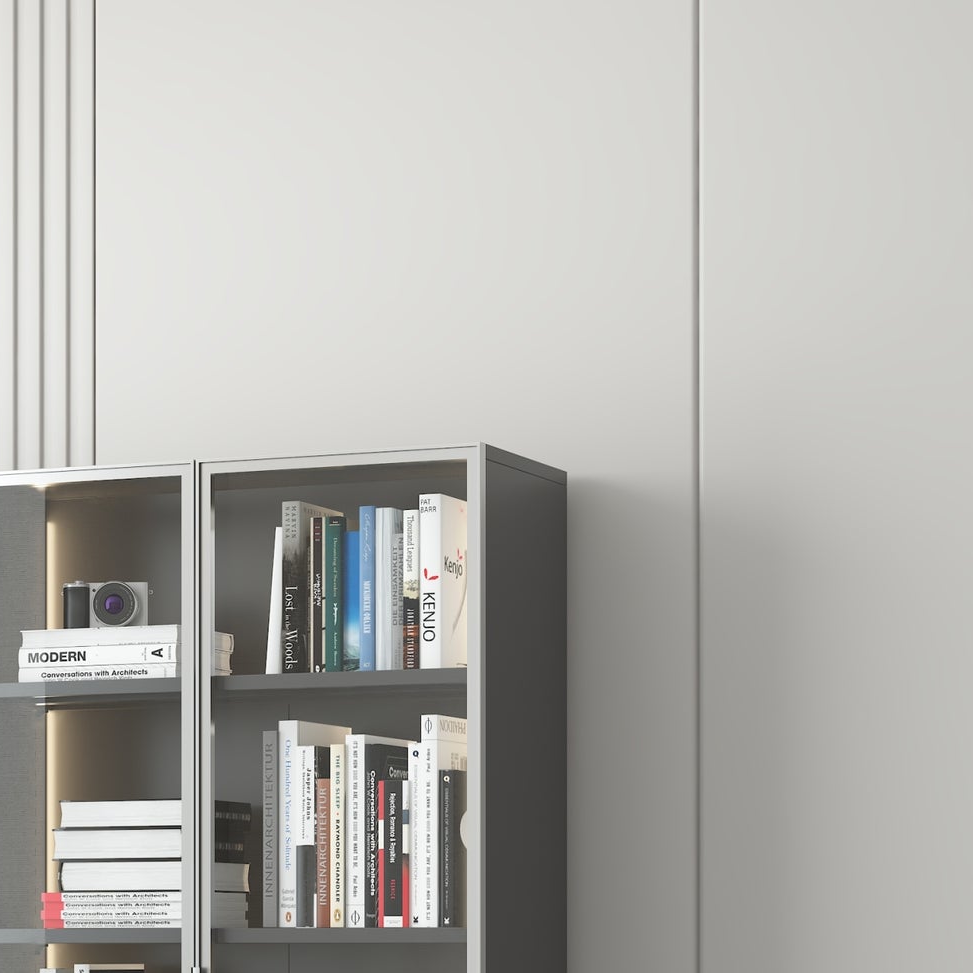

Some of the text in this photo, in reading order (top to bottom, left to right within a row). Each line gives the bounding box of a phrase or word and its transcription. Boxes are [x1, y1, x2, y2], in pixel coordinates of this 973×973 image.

[405, 515, 414, 573] Thousand Leagues
[445, 556, 463, 579] Kenjo
[285, 586, 298, 611] Lost
[423, 592, 435, 642] KENJO
[28, 651, 86, 663] MODERN
[285, 629, 298, 670] Woods
[41, 668, 148, 679] Conversations with Architects
[319, 788, 327, 905] INNENARCHITEKTUR
